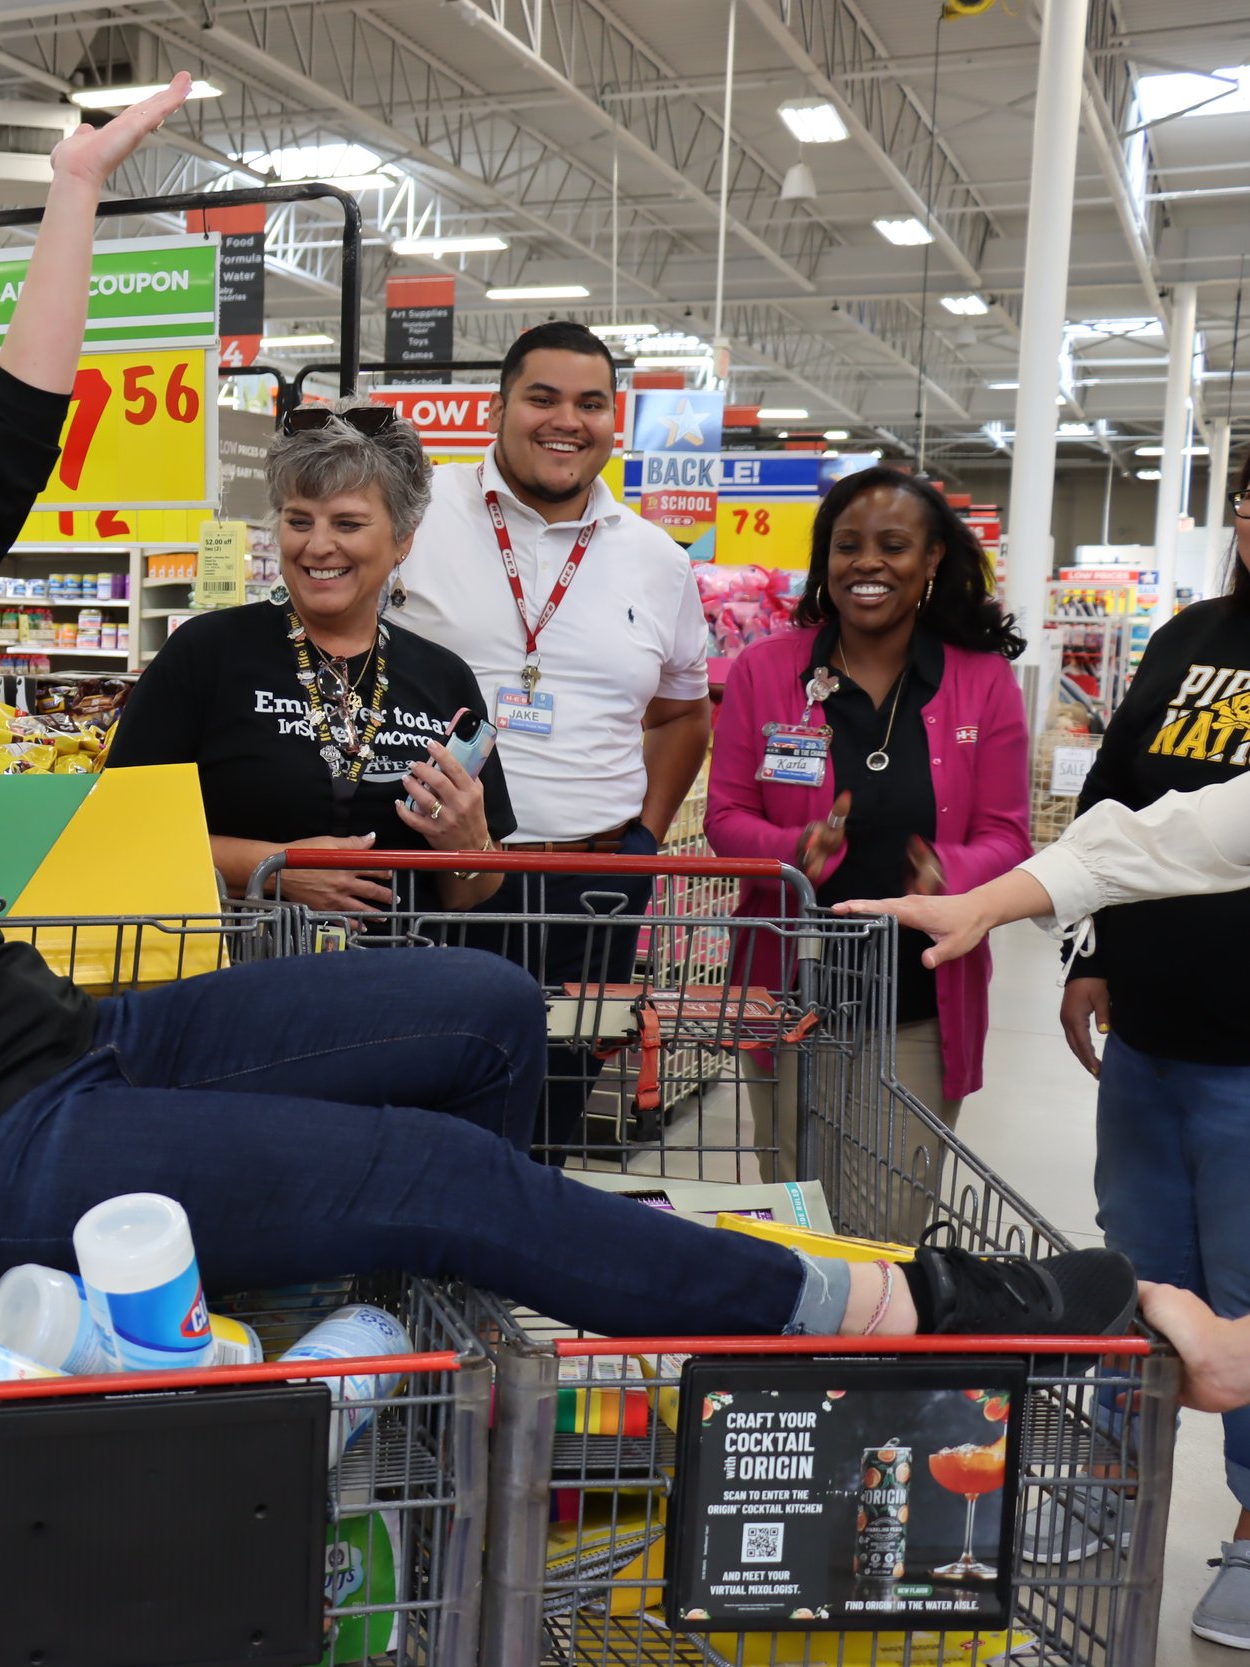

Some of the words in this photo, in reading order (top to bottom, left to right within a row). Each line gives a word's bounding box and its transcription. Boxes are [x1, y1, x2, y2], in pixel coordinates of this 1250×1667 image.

[225, 236, 254, 248] Food
[223, 271, 255, 282] Water
[88, 270, 189, 296] COUPON
[391, 310, 406, 319] Art
[408, 308, 448, 319] Supplies
[408, 337, 429, 347] Toys
[402, 351, 433, 360] Games
[122, 363, 199, 426] 56
[396, 401, 469, 426] LOW
[647, 457, 715, 487] BACK
[661, 495, 713, 512] SCHOOL
[733, 509, 771, 536] 78
[509, 710, 539, 721] JAKE
[777, 758, 807, 770] Karla
[1059, 761, 1087, 777] SALE
[726, 1412, 774, 1429] CRAFT
[779, 1412, 817, 1428] YOUR
[724, 1432, 815, 1452] COCKTAIL
[724, 1456, 736, 1480] with
[739, 1455, 814, 1480] ORIGIN
[723, 1490, 747, 1501] SCAN
[749, 1490, 760, 1500] TO
[761, 1490, 790, 1500] ENTER
[792, 1489, 809, 1499] THE
[865, 1489, 907, 1505] ORIGIN
[742, 1504, 783, 1514] COCKTAIL
[785, 1503, 823, 1514] KITCHEN
[722, 1571, 741, 1581] AND
[742, 1571, 766, 1581] MEET
[767, 1570, 791, 1581] YOUR
[710, 1585, 746, 1595] VIRTUAL
[748, 1584, 801, 1595] MIXOLOGIST.
[845, 1601, 864, 1610] FIND
[865, 1601, 892, 1610] ORIGIN
[897, 1601, 906, 1610] IN
[908, 1601, 924, 1610] THE
[925, 1600, 952, 1610] WATER
[953, 1600, 979, 1610] AISLE.
